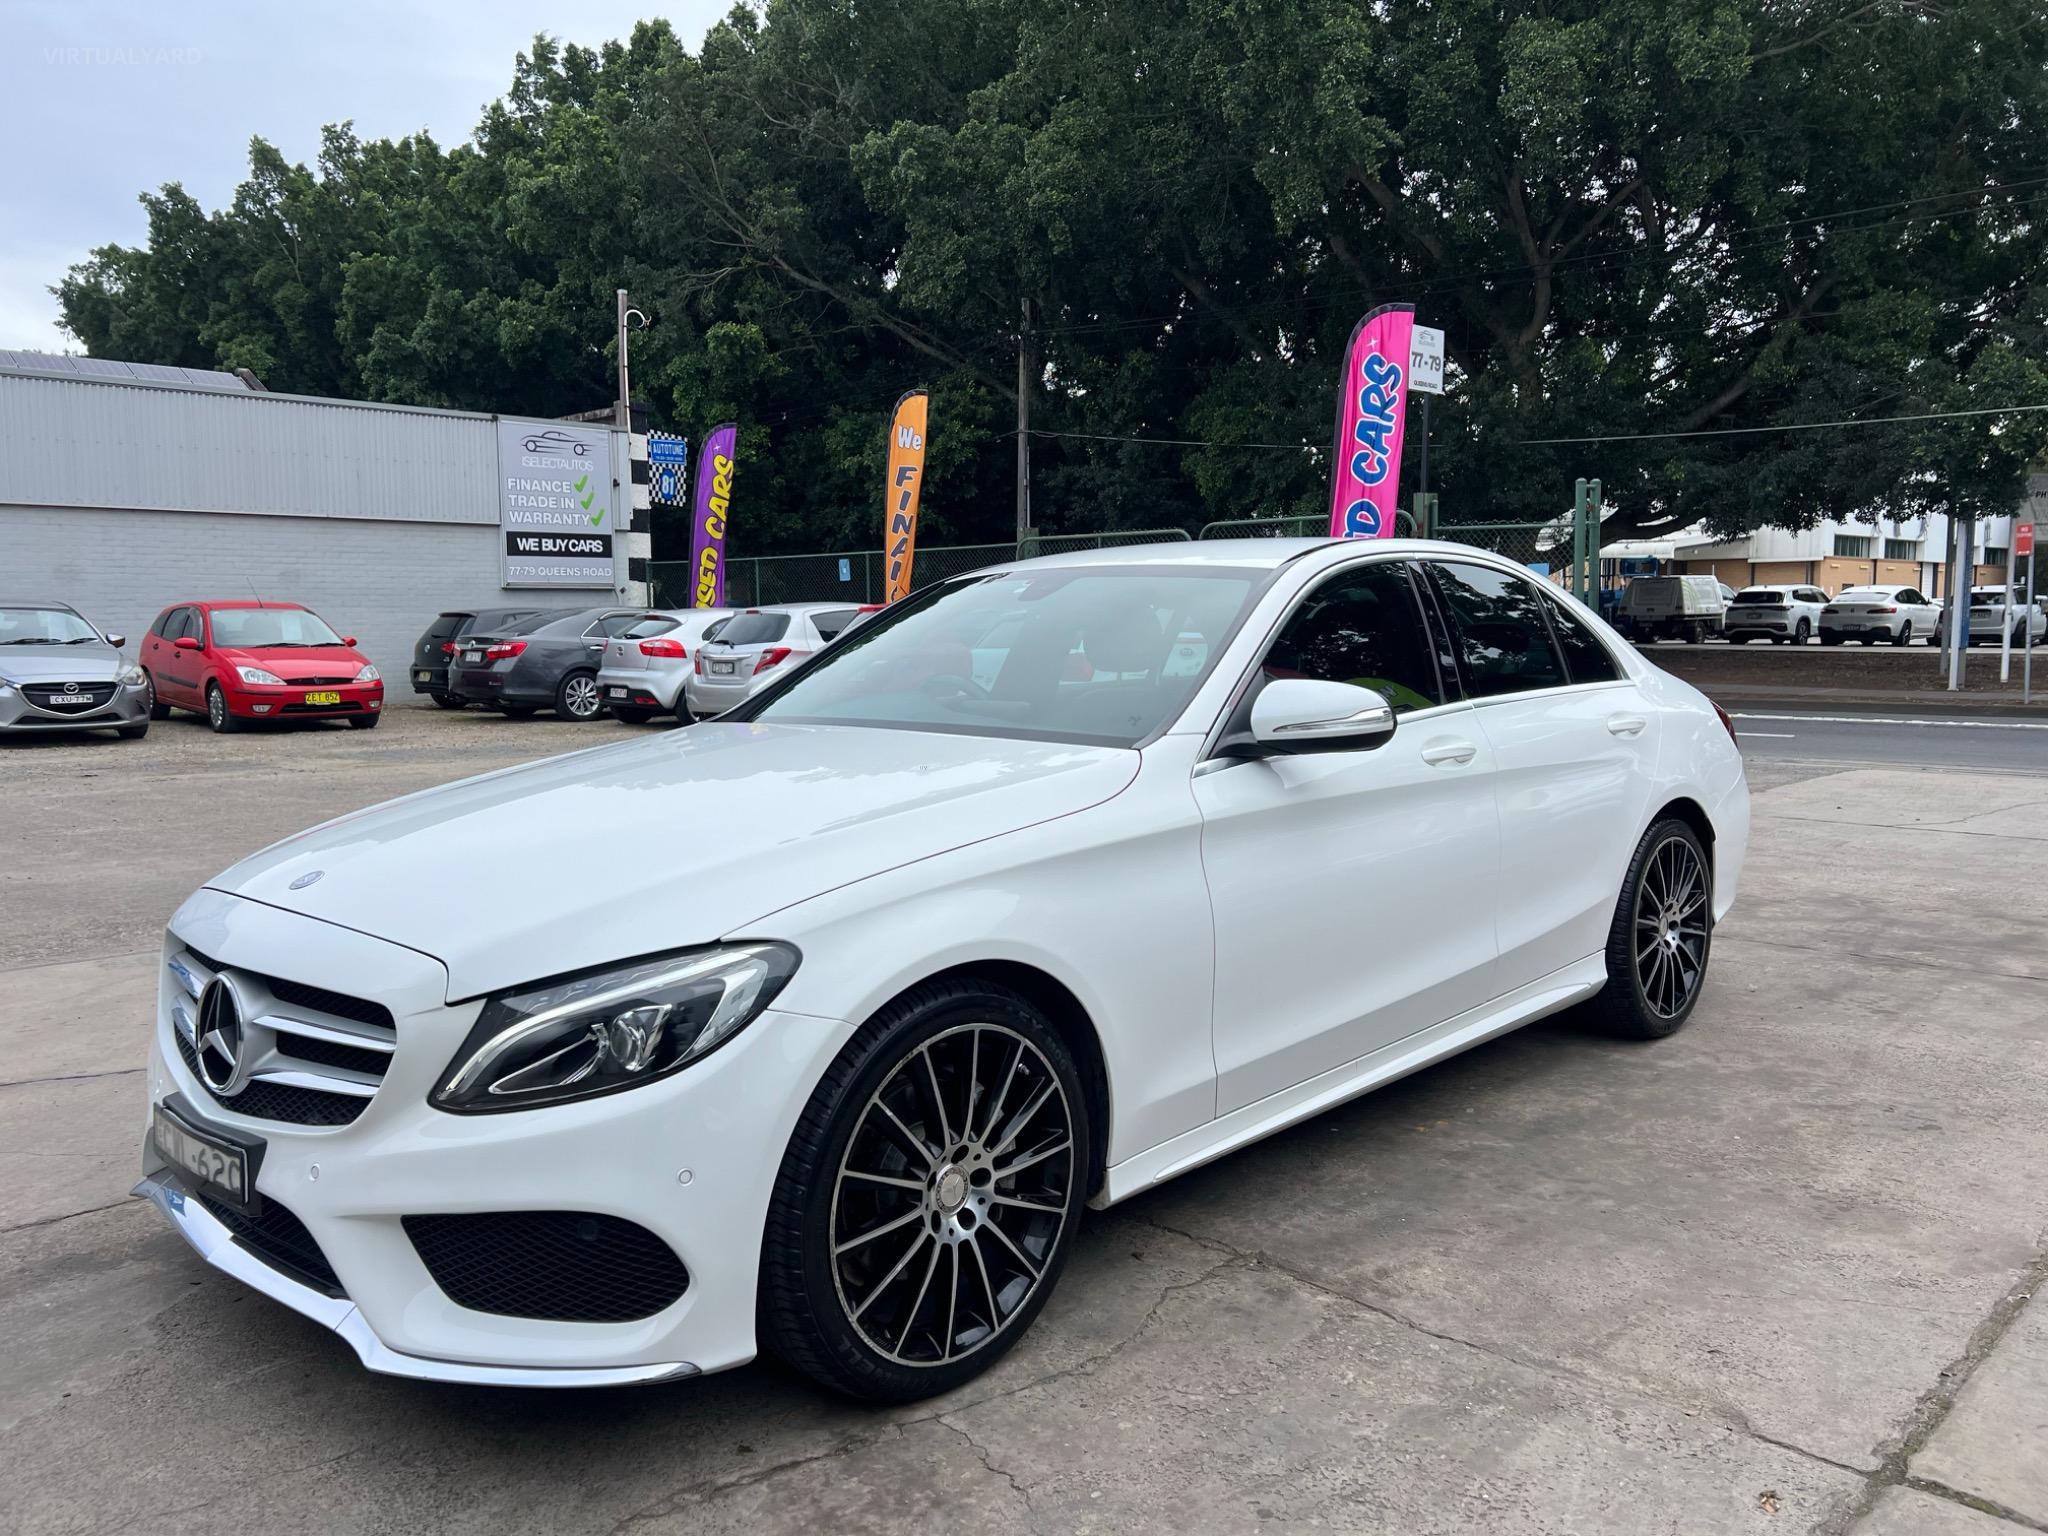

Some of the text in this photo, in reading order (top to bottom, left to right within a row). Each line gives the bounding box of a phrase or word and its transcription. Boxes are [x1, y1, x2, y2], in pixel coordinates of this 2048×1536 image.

[1351, 352, 1403, 487] CARS
[898, 425, 922, 450] We
[507, 478, 571, 493] FINANCE
[662, 475, 674, 496] 81
[508, 494, 575, 509] TRADE IN
[705, 454, 734, 540] CARS
[509, 511, 590, 526] WARRANTY
[516, 537, 603, 553] WE BUY CARS
[538, 567, 581, 576] QUEENS
[583, 568, 612, 577] ROAD
